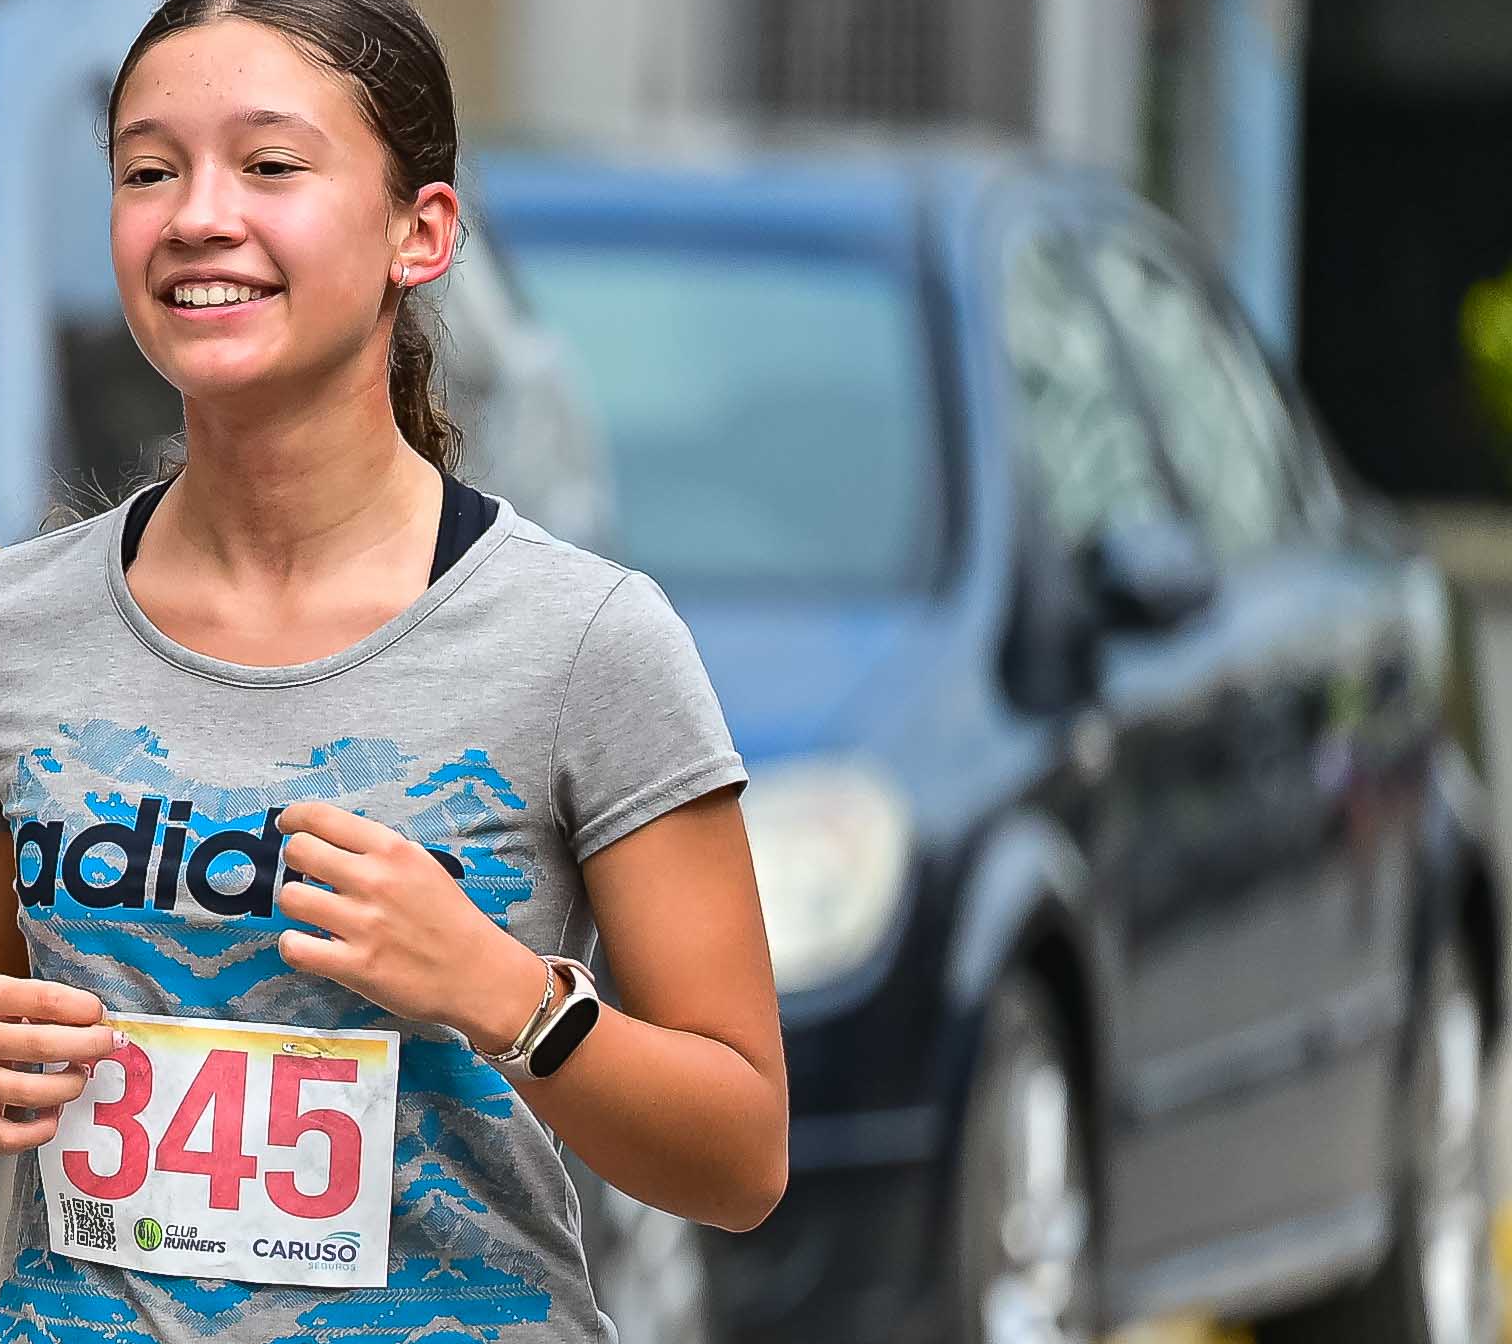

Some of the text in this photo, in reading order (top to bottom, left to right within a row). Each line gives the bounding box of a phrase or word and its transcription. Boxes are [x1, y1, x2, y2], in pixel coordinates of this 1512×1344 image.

[61, 1040, 364, 1220] 345
[165, 1224, 199, 1239] CLUB
[163, 1236, 226, 1254] RUNNER'S
[252, 1238, 357, 1263] CARUSO
[307, 1261, 357, 1272] SEGUROS
